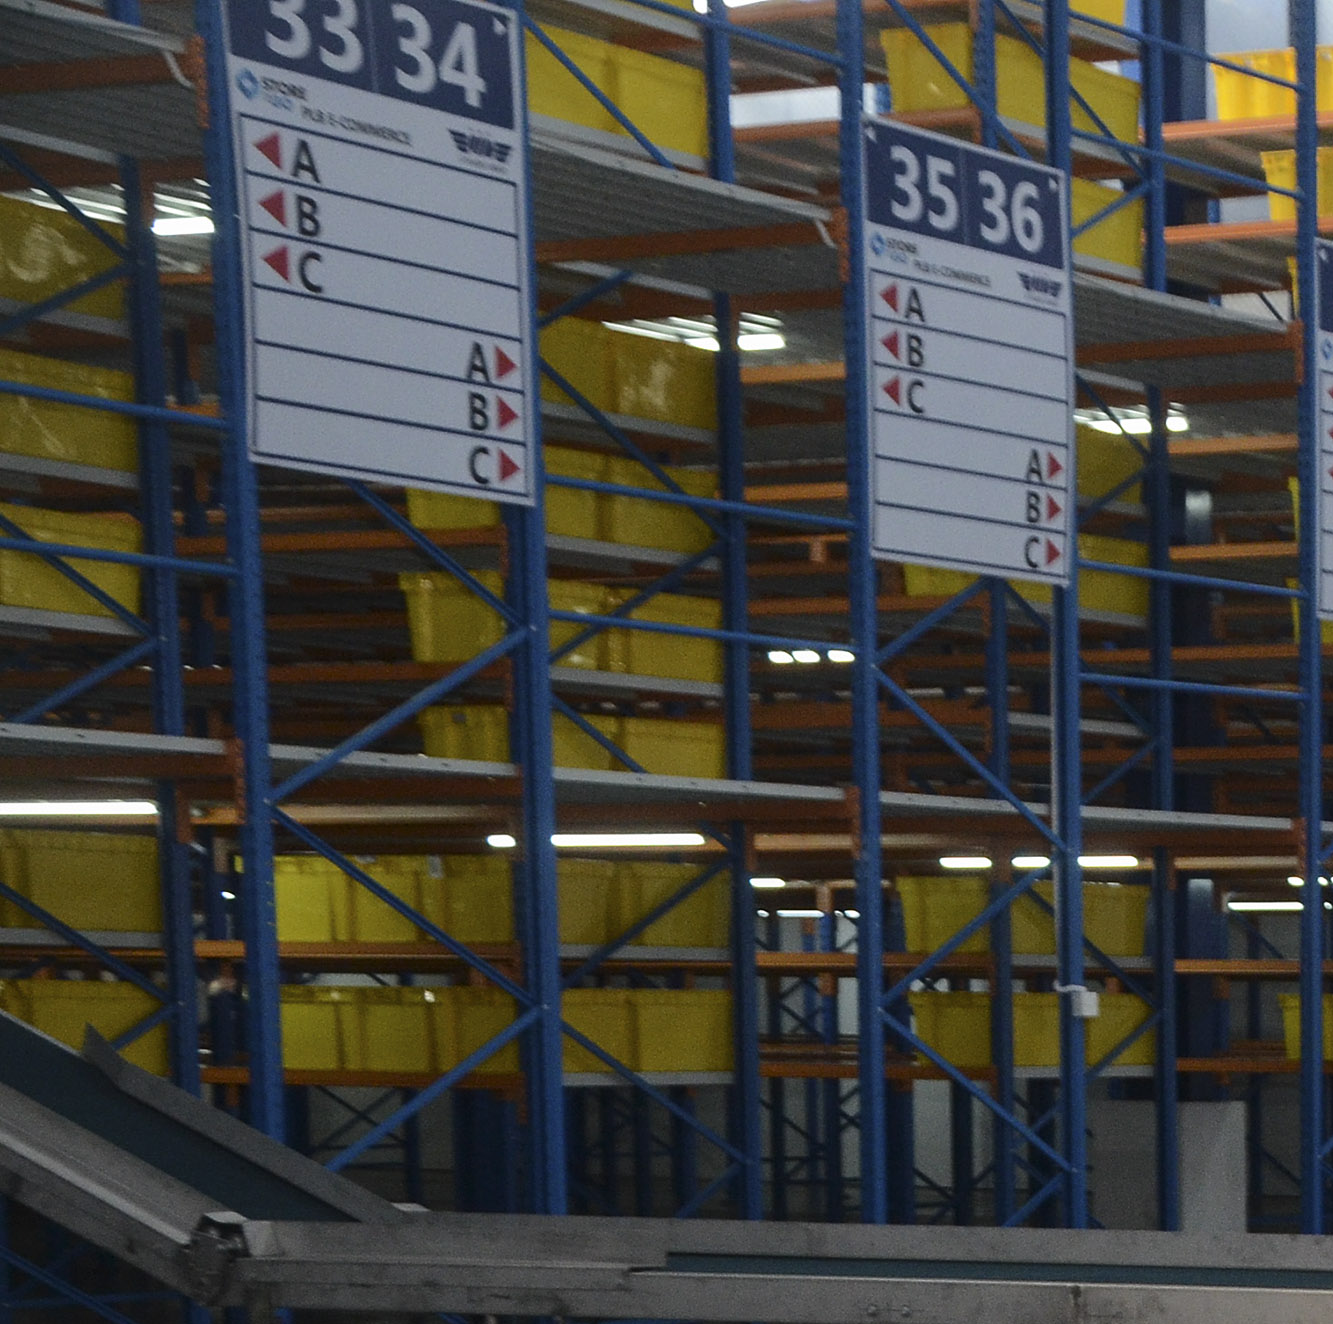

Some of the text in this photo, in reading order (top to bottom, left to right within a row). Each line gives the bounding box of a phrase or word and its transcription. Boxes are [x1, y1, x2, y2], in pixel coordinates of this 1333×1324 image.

[267, 0, 485, 107] 33 34
[291, 140, 320, 183] A
[296, 194, 320, 237] B
[891, 146, 1043, 252] 35 36
[299, 251, 323, 293] C
[905, 288, 925, 322] A
[465, 342, 490, 384] A
[907, 334, 924, 368] B
[469, 392, 488, 431] B
[907, 380, 924, 414] C
[469, 446, 489, 485] C
[1026, 449, 1042, 481] A
[1027, 491, 1041, 523] B
[1024, 537, 1039, 568] C
